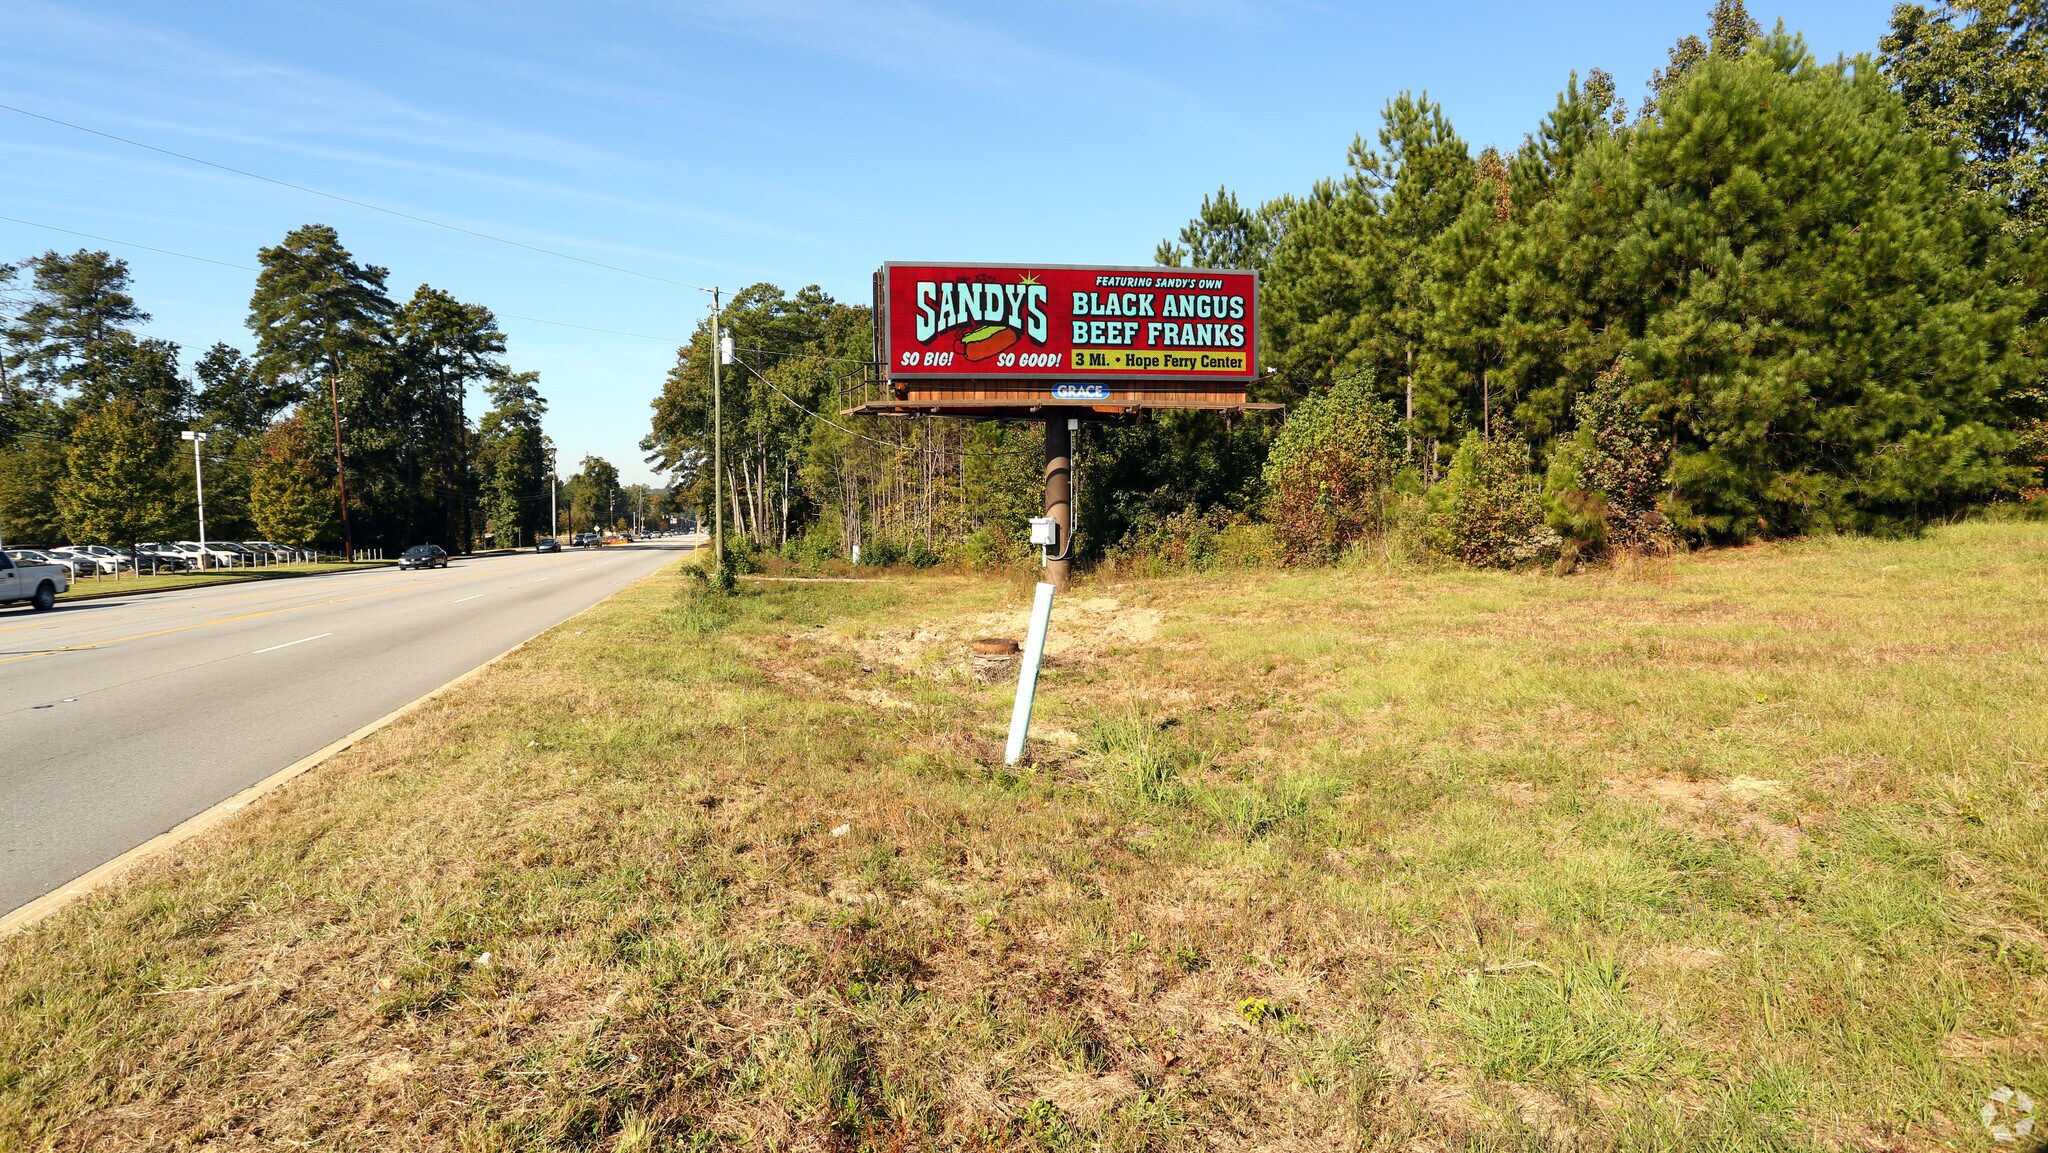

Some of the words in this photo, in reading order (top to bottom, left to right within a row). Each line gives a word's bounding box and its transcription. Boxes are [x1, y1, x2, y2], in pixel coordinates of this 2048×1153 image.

[1096, 276, 1152, 288] FEATURING
[1155, 278, 1196, 289] SANDY'S
[1198, 279, 1223, 290] OWN
[1072, 292, 1155, 317] BLACK
[1162, 294, 1244, 319] ANGUS
[1072, 321, 1139, 345] BEEF
[1147, 322, 1245, 347] FRANKS
[901, 351, 921, 366] SO
[923, 351, 955, 367] BIG!
[996, 352, 1016, 368] SO
[1018, 352, 1063, 368] GOOD!
[1075, 353, 1085, 366] 3
[1089, 353, 1110, 367] Mi.
[1125, 353, 1160, 370] Hope
[1163, 354, 1197, 370] Ferry
[1200, 354, 1243, 369] Center
[1057, 384, 1103, 398] GRACE
